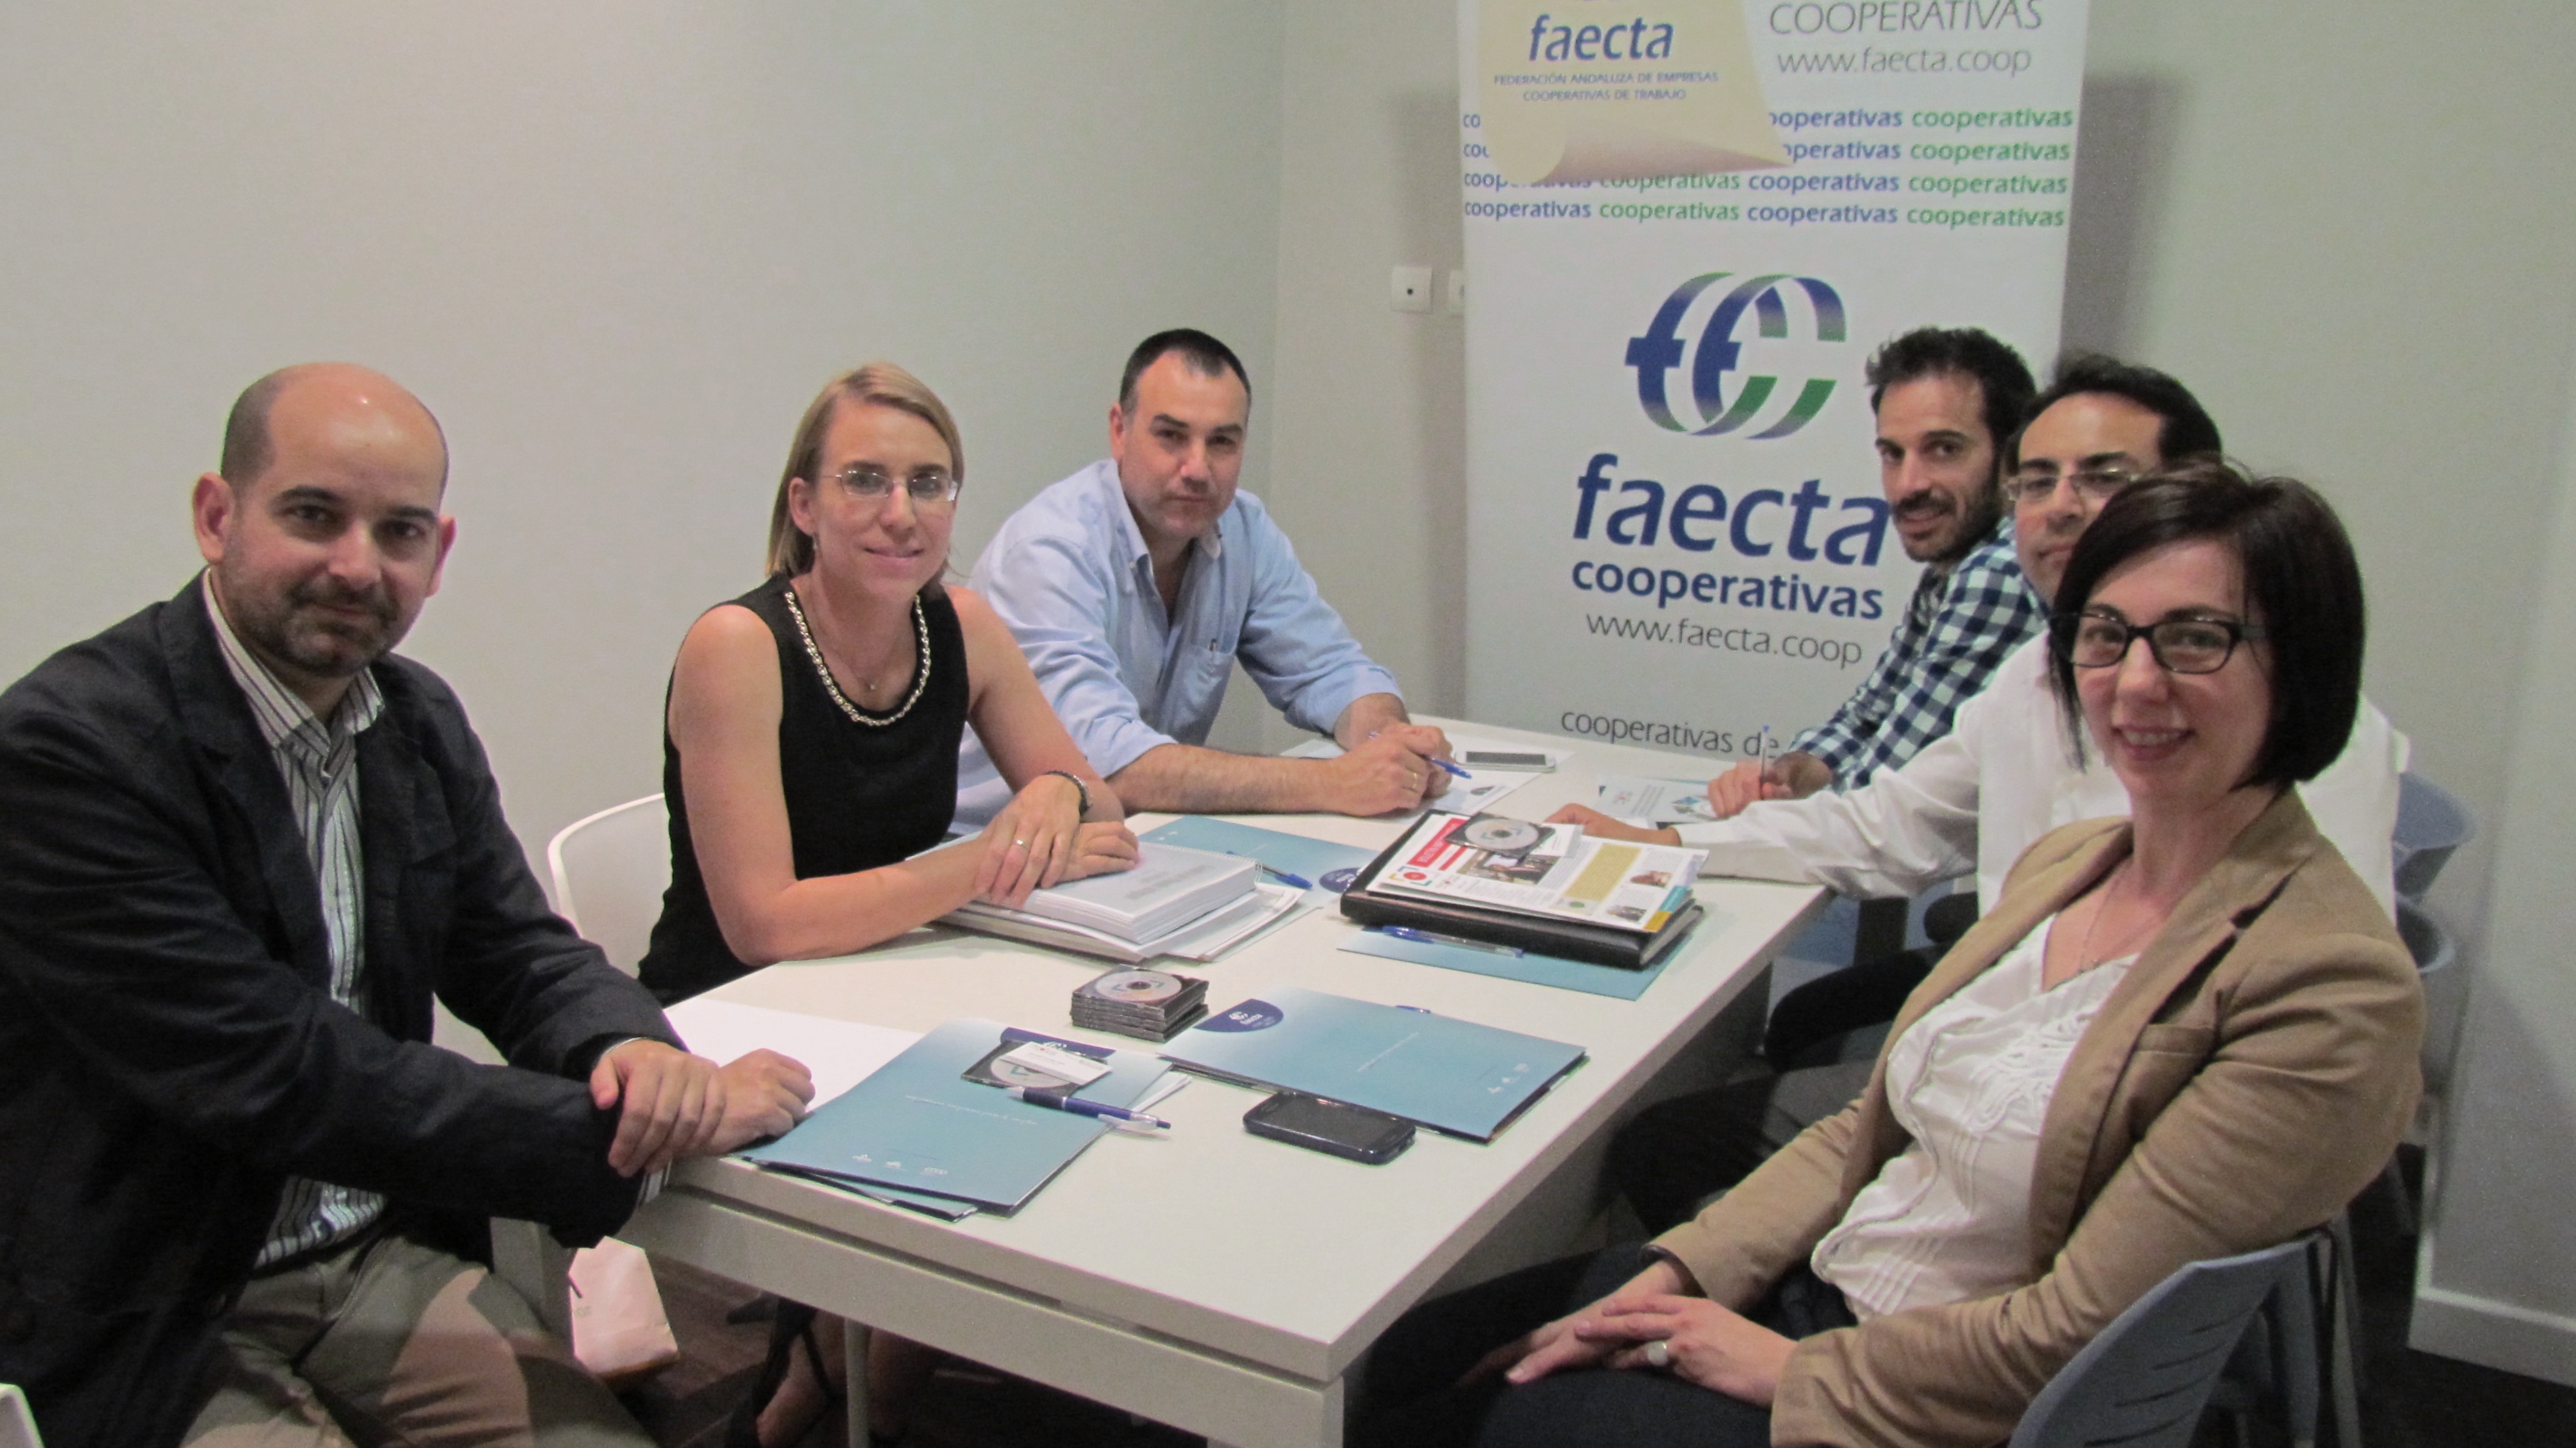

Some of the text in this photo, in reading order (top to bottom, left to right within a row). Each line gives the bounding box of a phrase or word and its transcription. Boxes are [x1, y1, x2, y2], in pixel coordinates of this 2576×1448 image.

[1529, 13, 1674, 61] faecta
[1778, 47, 2032, 78] www.faecta.coop
[1494, 70, 1719, 85] FEDERACIÓN ANDALUZA DE EMPRESAS
[1523, 88, 1686, 102] COOPERATIVAS DE TRABAJO
[1912, 107, 2074, 132] cooperativas
[1910, 141, 2070, 164] cooperativas
[1748, 172, 1900, 195] cooperativas
[1908, 175, 2068, 198] cooperativas
[1600, 202, 1740, 224] cooperativas
[1746, 205, 1898, 226] cooperativas
[1907, 208, 2065, 230] cooperativas
[1572, 453, 1891, 567] faecta
[1571, 560, 1884, 620] cooperativas
[1587, 613, 1863, 670] www.faecta.coop
[1561, 711, 1734, 754] cooperativas
